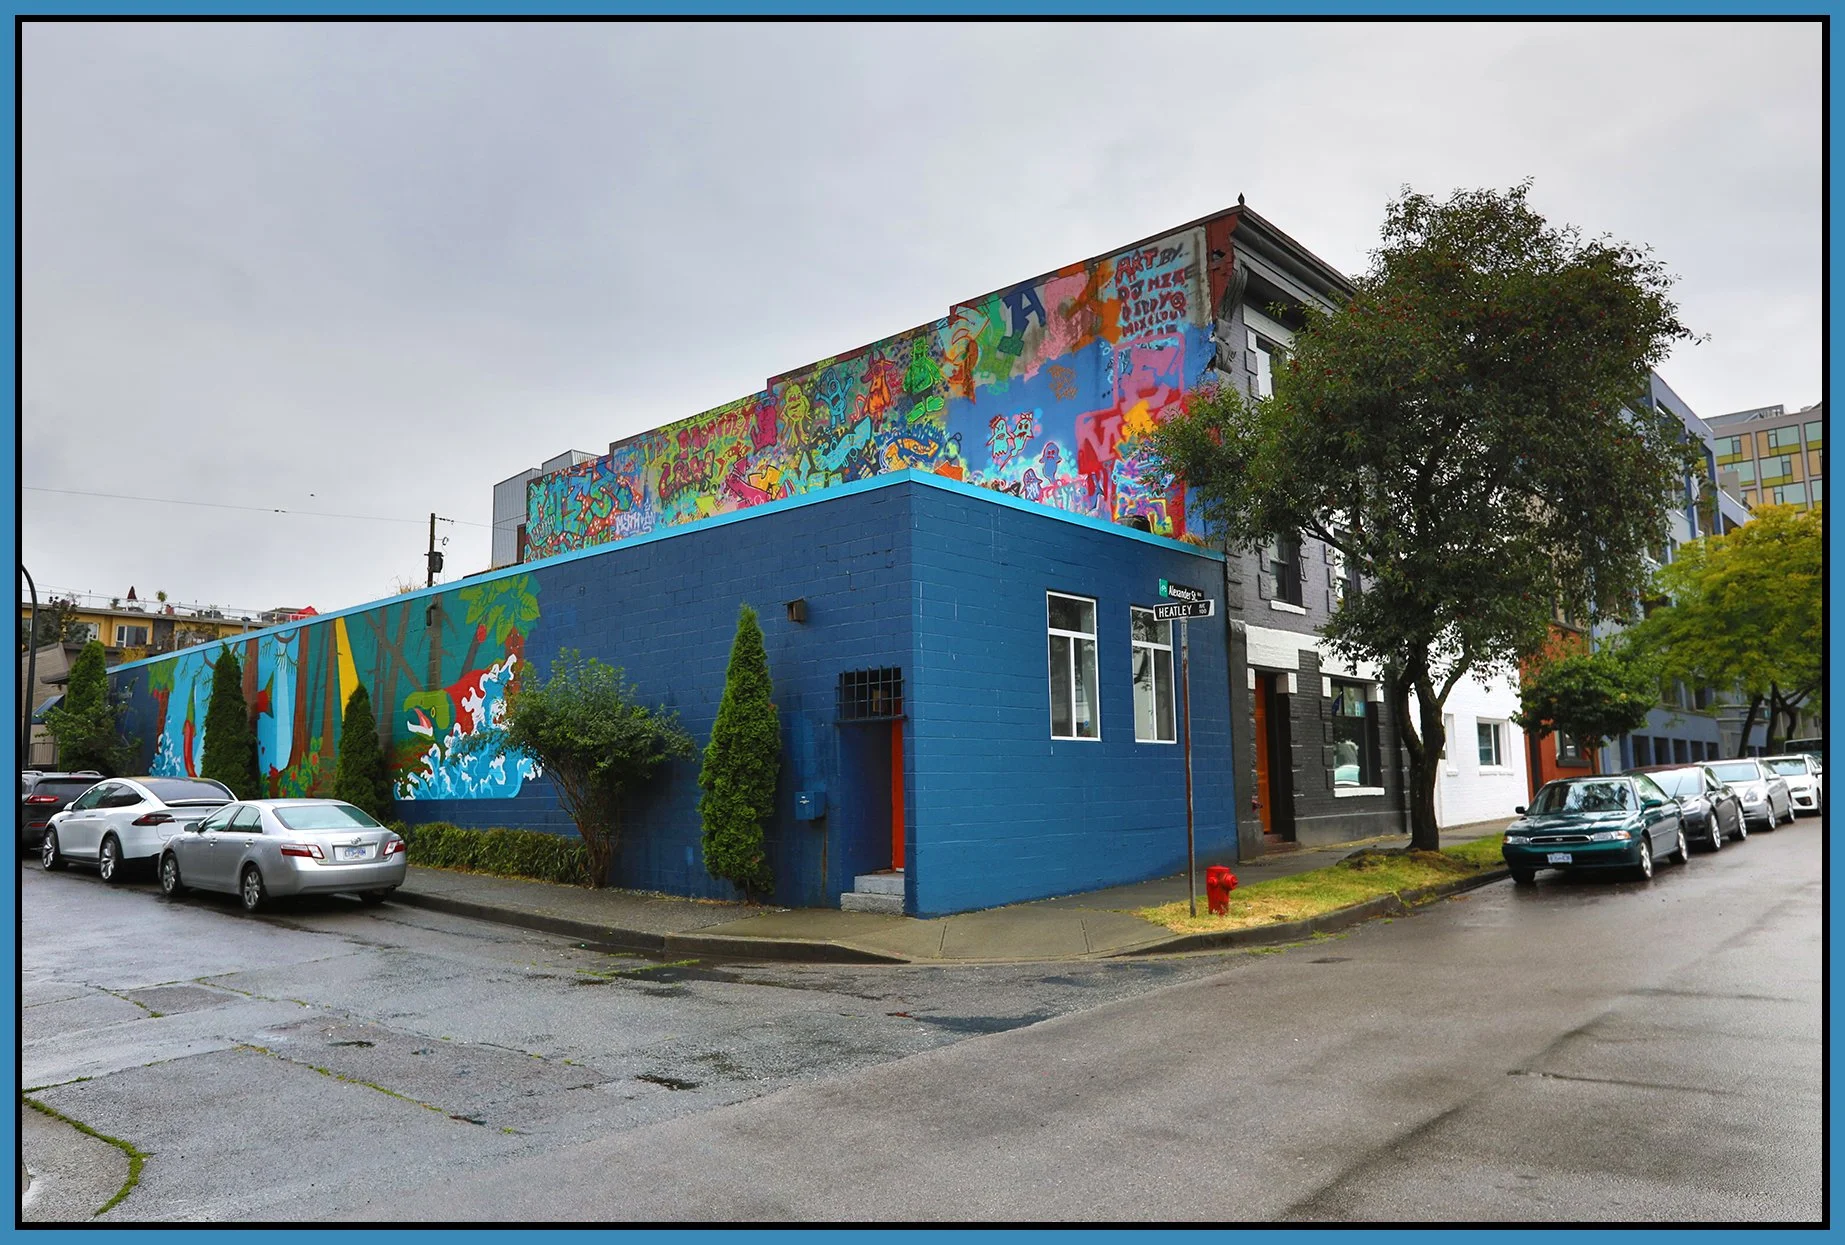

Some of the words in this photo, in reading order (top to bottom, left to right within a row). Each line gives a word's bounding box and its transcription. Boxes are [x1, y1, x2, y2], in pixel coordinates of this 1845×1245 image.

[1115, 247, 1158, 287] ART
[1169, 585, 1191, 600] Alexander
[1159, 605, 1192, 617] HEATLEY
